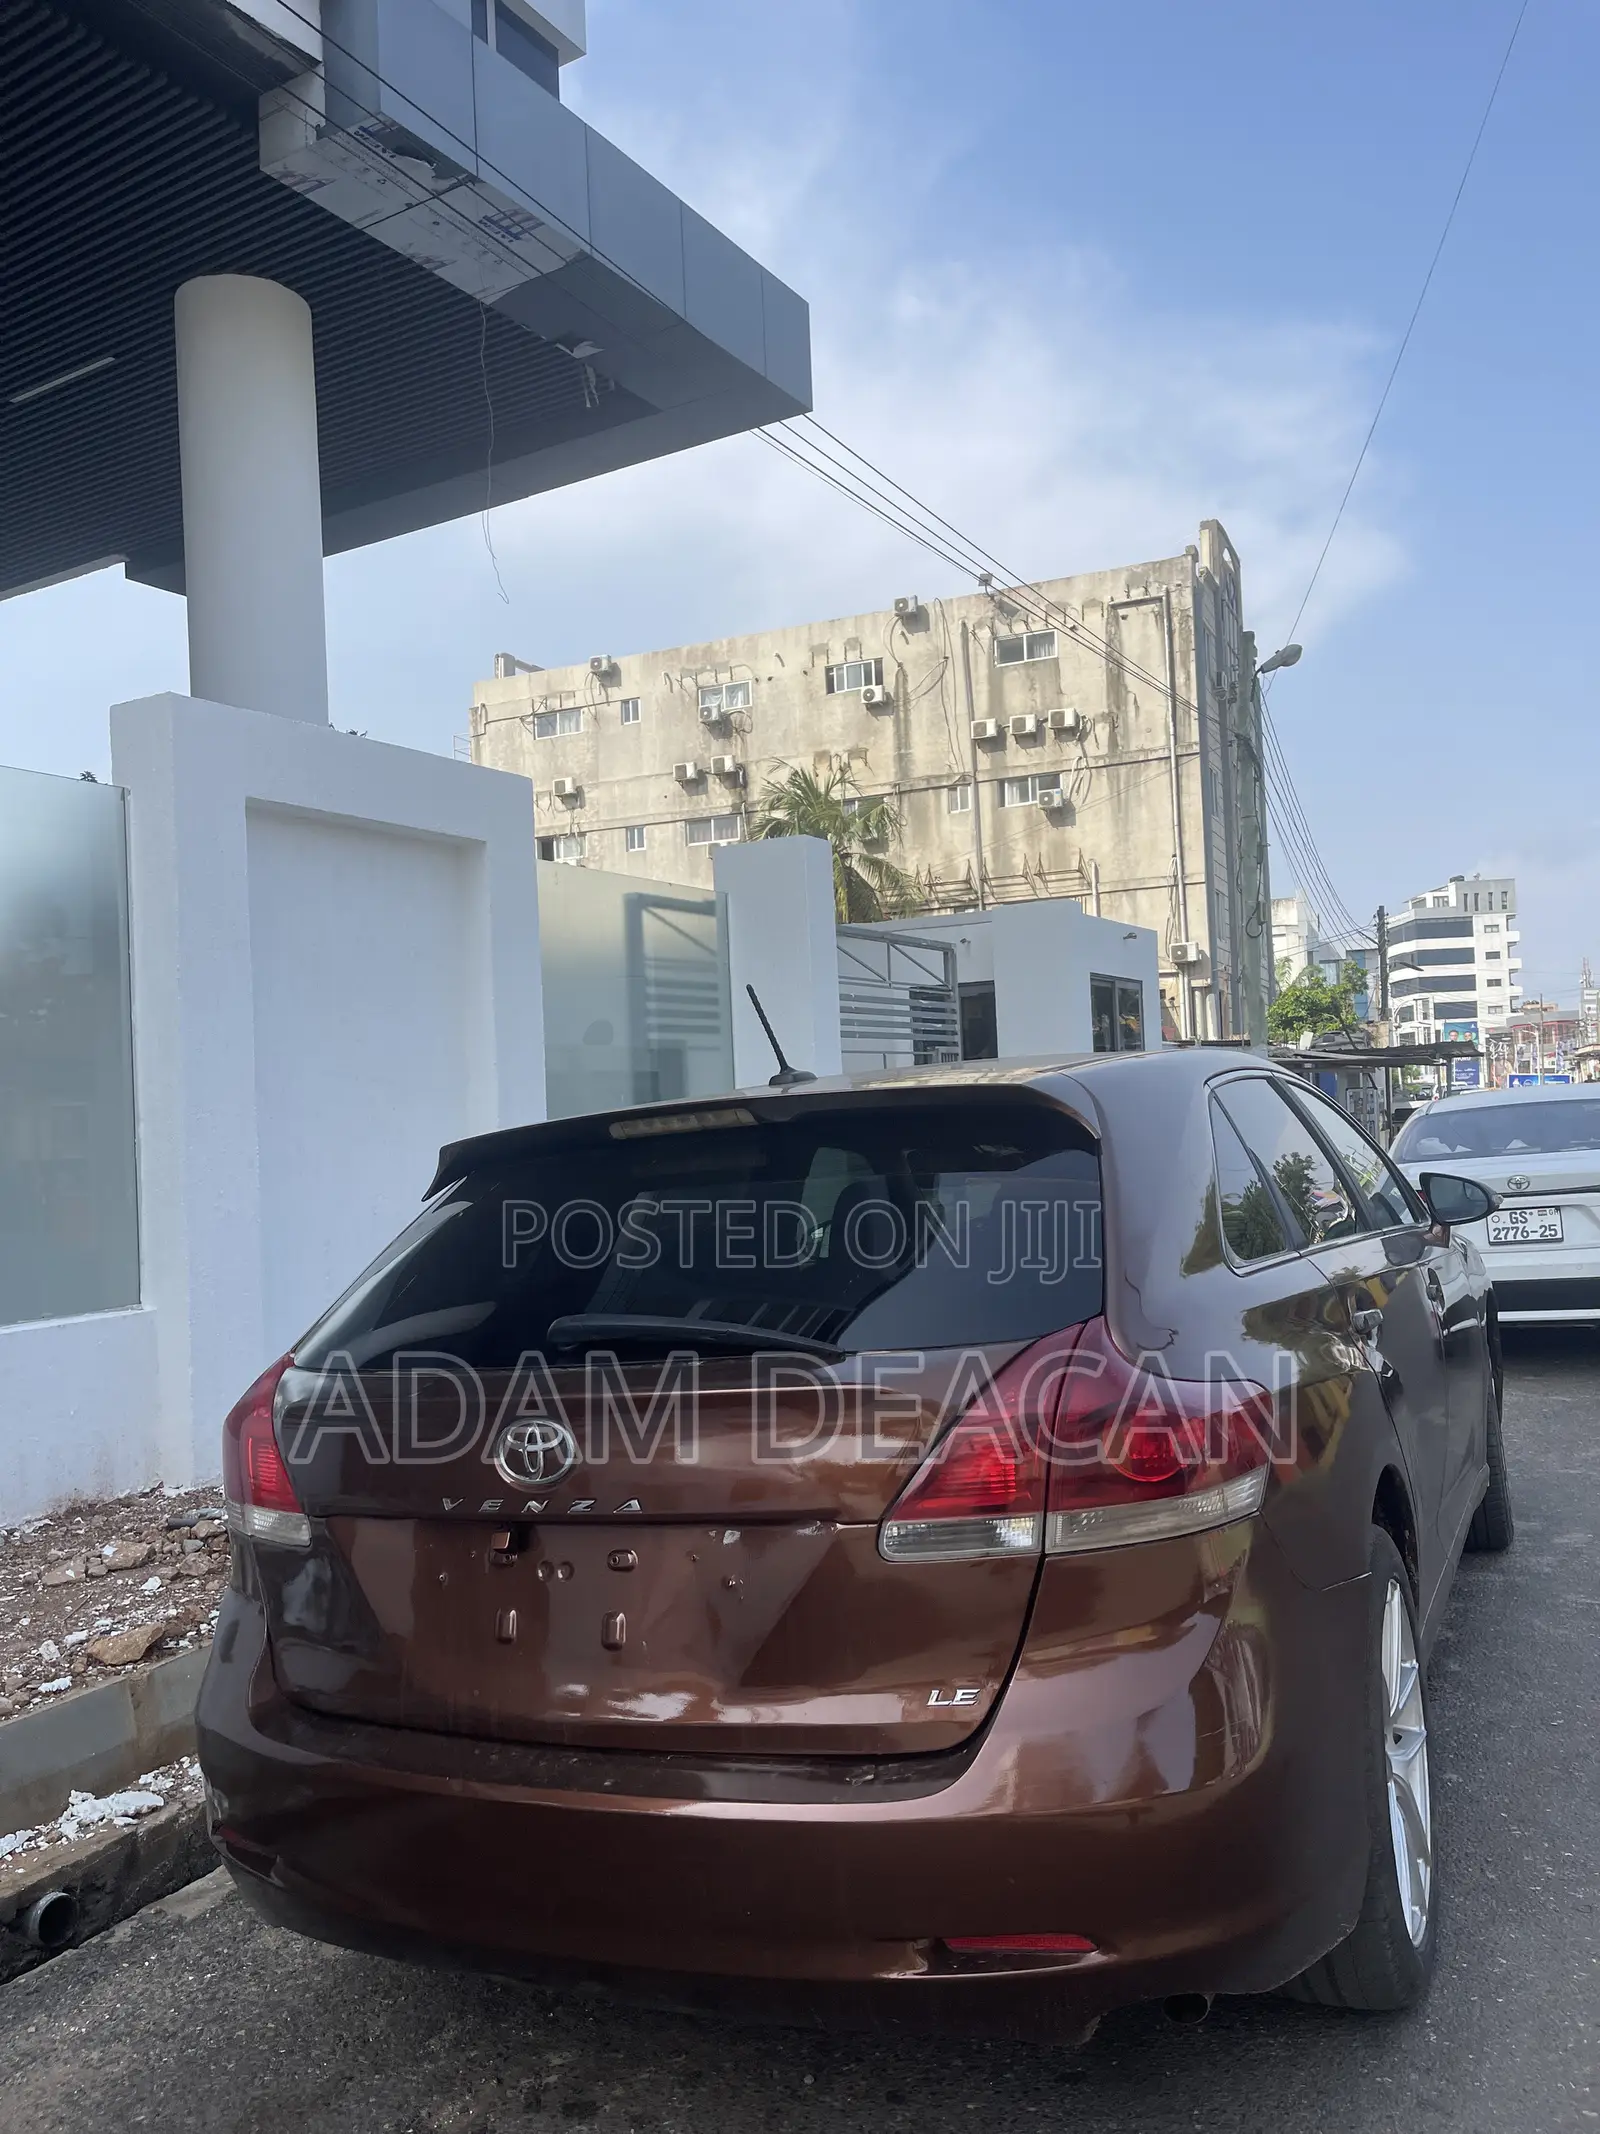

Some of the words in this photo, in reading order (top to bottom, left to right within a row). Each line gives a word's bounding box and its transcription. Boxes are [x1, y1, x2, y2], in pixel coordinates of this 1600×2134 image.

[1509, 1210, 1529, 1225] GS
[1492, 1224, 1558, 1241] 2776-25
[442, 1497, 643, 1514] VENZA
[926, 1688, 981, 1706] LE
